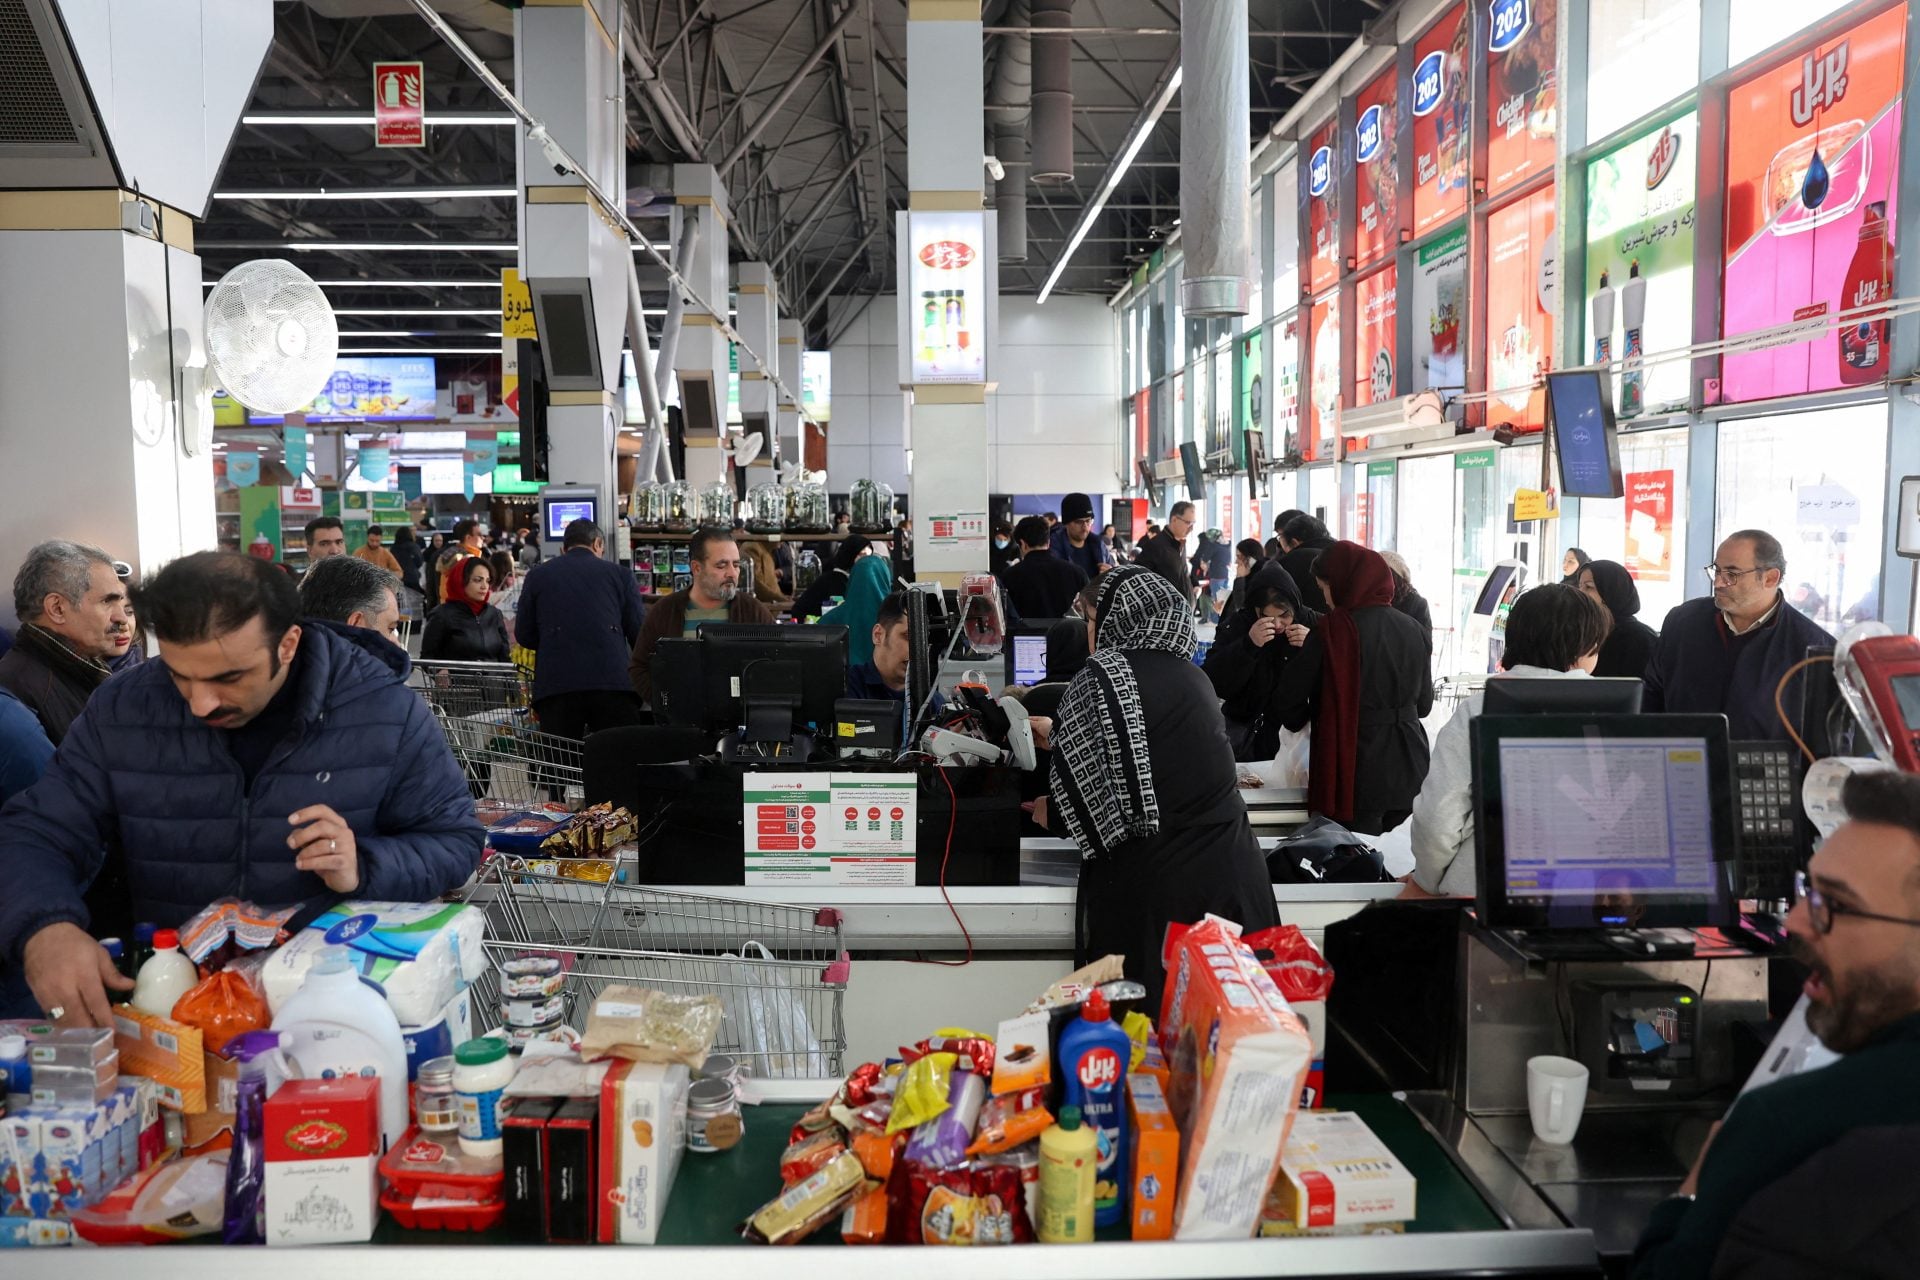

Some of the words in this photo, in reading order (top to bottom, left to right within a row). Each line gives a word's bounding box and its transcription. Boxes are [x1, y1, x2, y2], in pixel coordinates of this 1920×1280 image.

[1496, 2, 1522, 41] 202
[1417, 76, 1438, 105] 202
[1792, 40, 1848, 125] پریل
[1496, 93, 1524, 127] Chicken
[1360, 125, 1376, 151] 202
[1313, 162, 1327, 188] 202
[1671, 219, 1678, 237] و
[1681, 207, 1695, 230] رکه
[1621, 230, 1646, 254] شیرین
[1646, 224, 1668, 245] جوش
[1853, 280, 1878, 306] پریل
[401, 363, 426, 373] EFES
[1080, 1055, 1116, 1085] پریل
[1083, 1103, 1114, 1115] ULTRA
